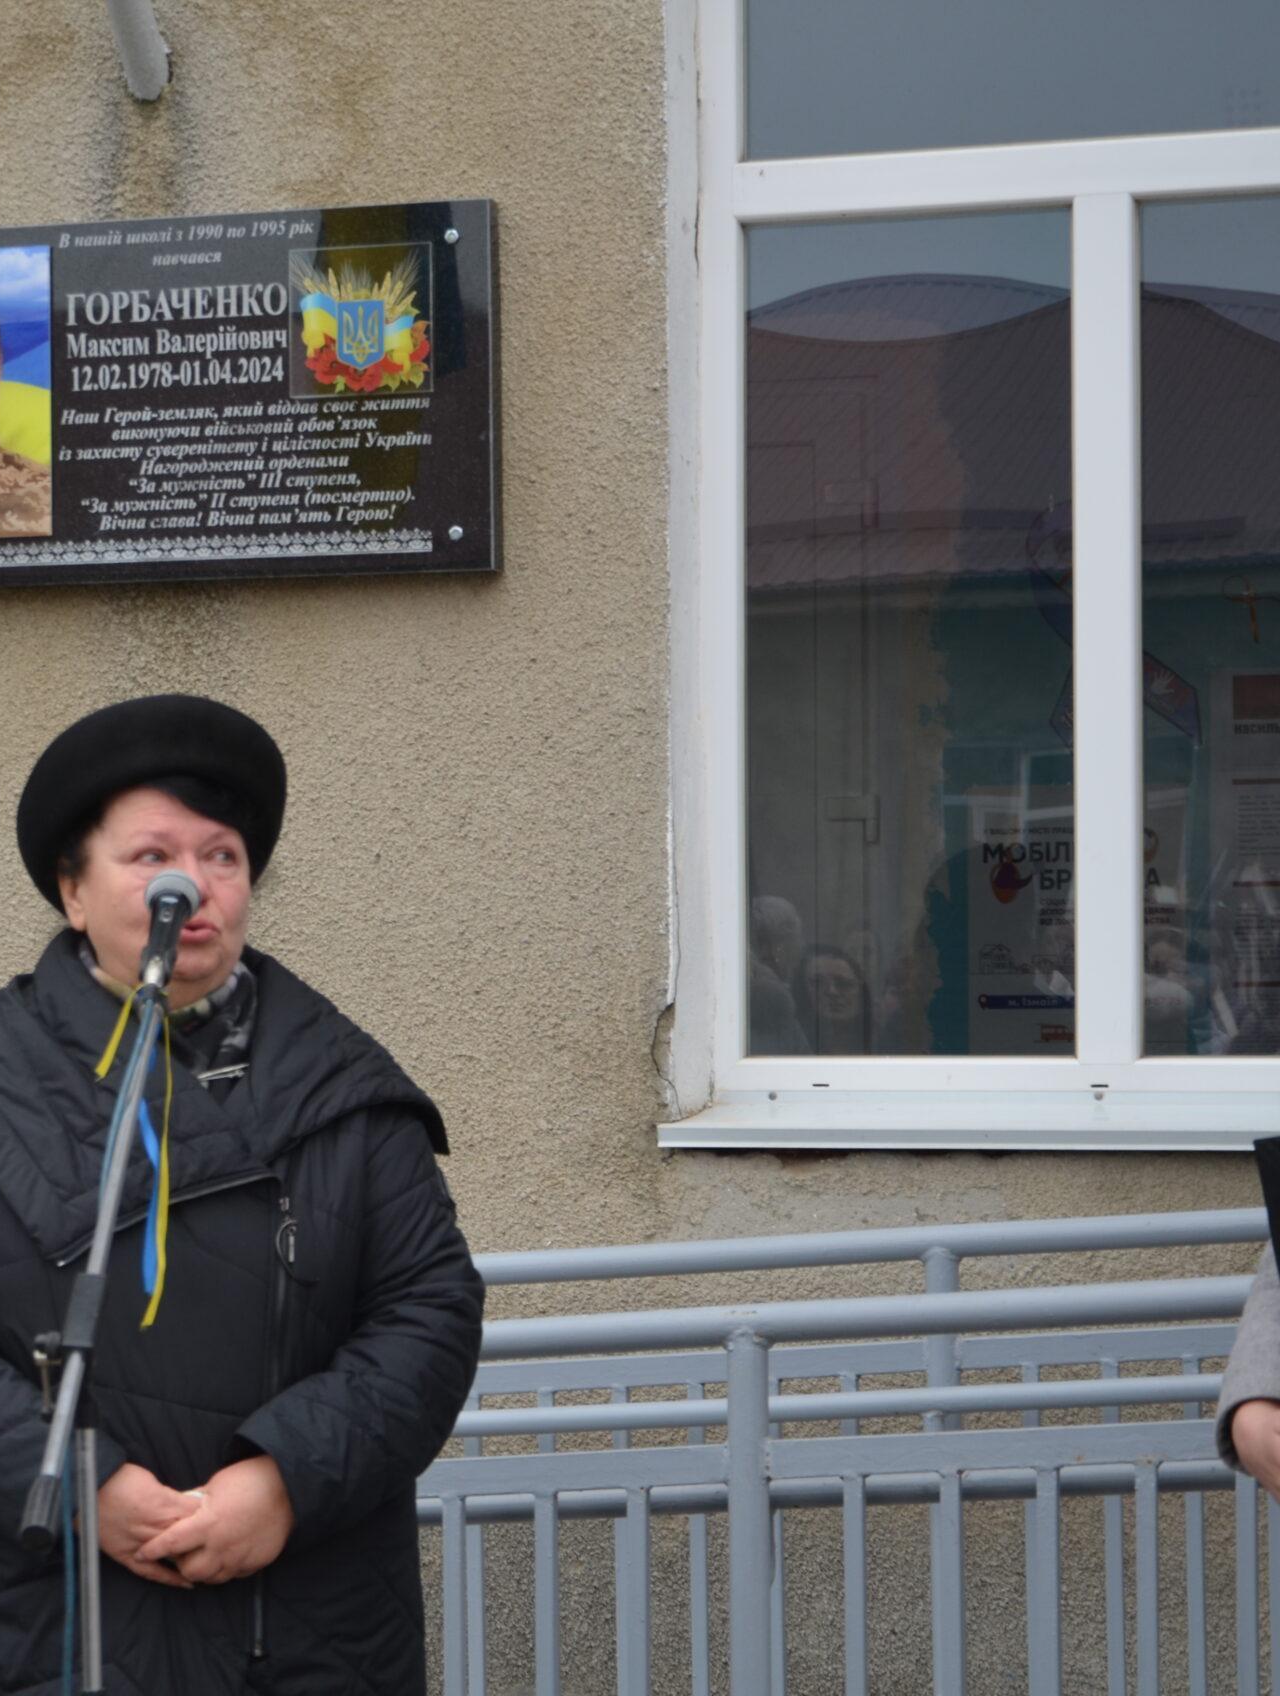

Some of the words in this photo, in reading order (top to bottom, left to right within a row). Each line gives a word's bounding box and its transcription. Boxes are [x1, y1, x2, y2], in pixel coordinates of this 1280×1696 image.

[59, 233, 70, 248] В
[75, 231, 121, 247] нашій
[126, 227, 171, 244] школі
[188, 224, 224, 241] 1990
[227, 226, 246, 239] по
[251, 220, 286, 237] 1995
[288, 219, 314, 238] рік
[152, 251, 222, 267] навчався
[66, 283, 287, 326] ГОРБАЧЕНКО
[67, 333, 150, 359] Максим
[156, 326, 287, 359] Валерійович
[71, 355, 284, 392] 12.02.1978-01.04.2024
[61, 409, 99, 425] Наш
[104, 406, 218, 426] Герой-земляк,
[222, 401, 263, 418] який
[268, 400, 318, 416] віддав
[323, 401, 357, 412] своє
[361, 397, 431, 411] життя
[111, 425, 200, 442] виконуючи
[204, 417, 293, 437] військовий
[298, 415, 378, 433] обов’язок
[59, 446, 71, 461] із
[75, 446, 143, 461] захисту
[146, 438, 258, 462] суверенітету
[261, 436, 268, 451] і
[272, 432, 361, 454] цілісності
[365, 431, 432, 450] України
[140, 455, 264, 477] Нагороджений
[269, 455, 349, 471] орденами
[159, 473, 257, 496] мужність”
[286, 472, 361, 490] ступеня,
[110, 494, 207, 515] мужність”
[229, 491, 299, 511] ступеня
[304, 486, 416, 507] (посмертно).
[99, 514, 146, 531] Вічна
[150, 512, 203, 528] слава!
[207, 509, 254, 527] Вічна
[259, 507, 331, 525] пам’ять
[335, 503, 397, 525] Герою!
[983, 841, 1073, 863] МОБІЛ
